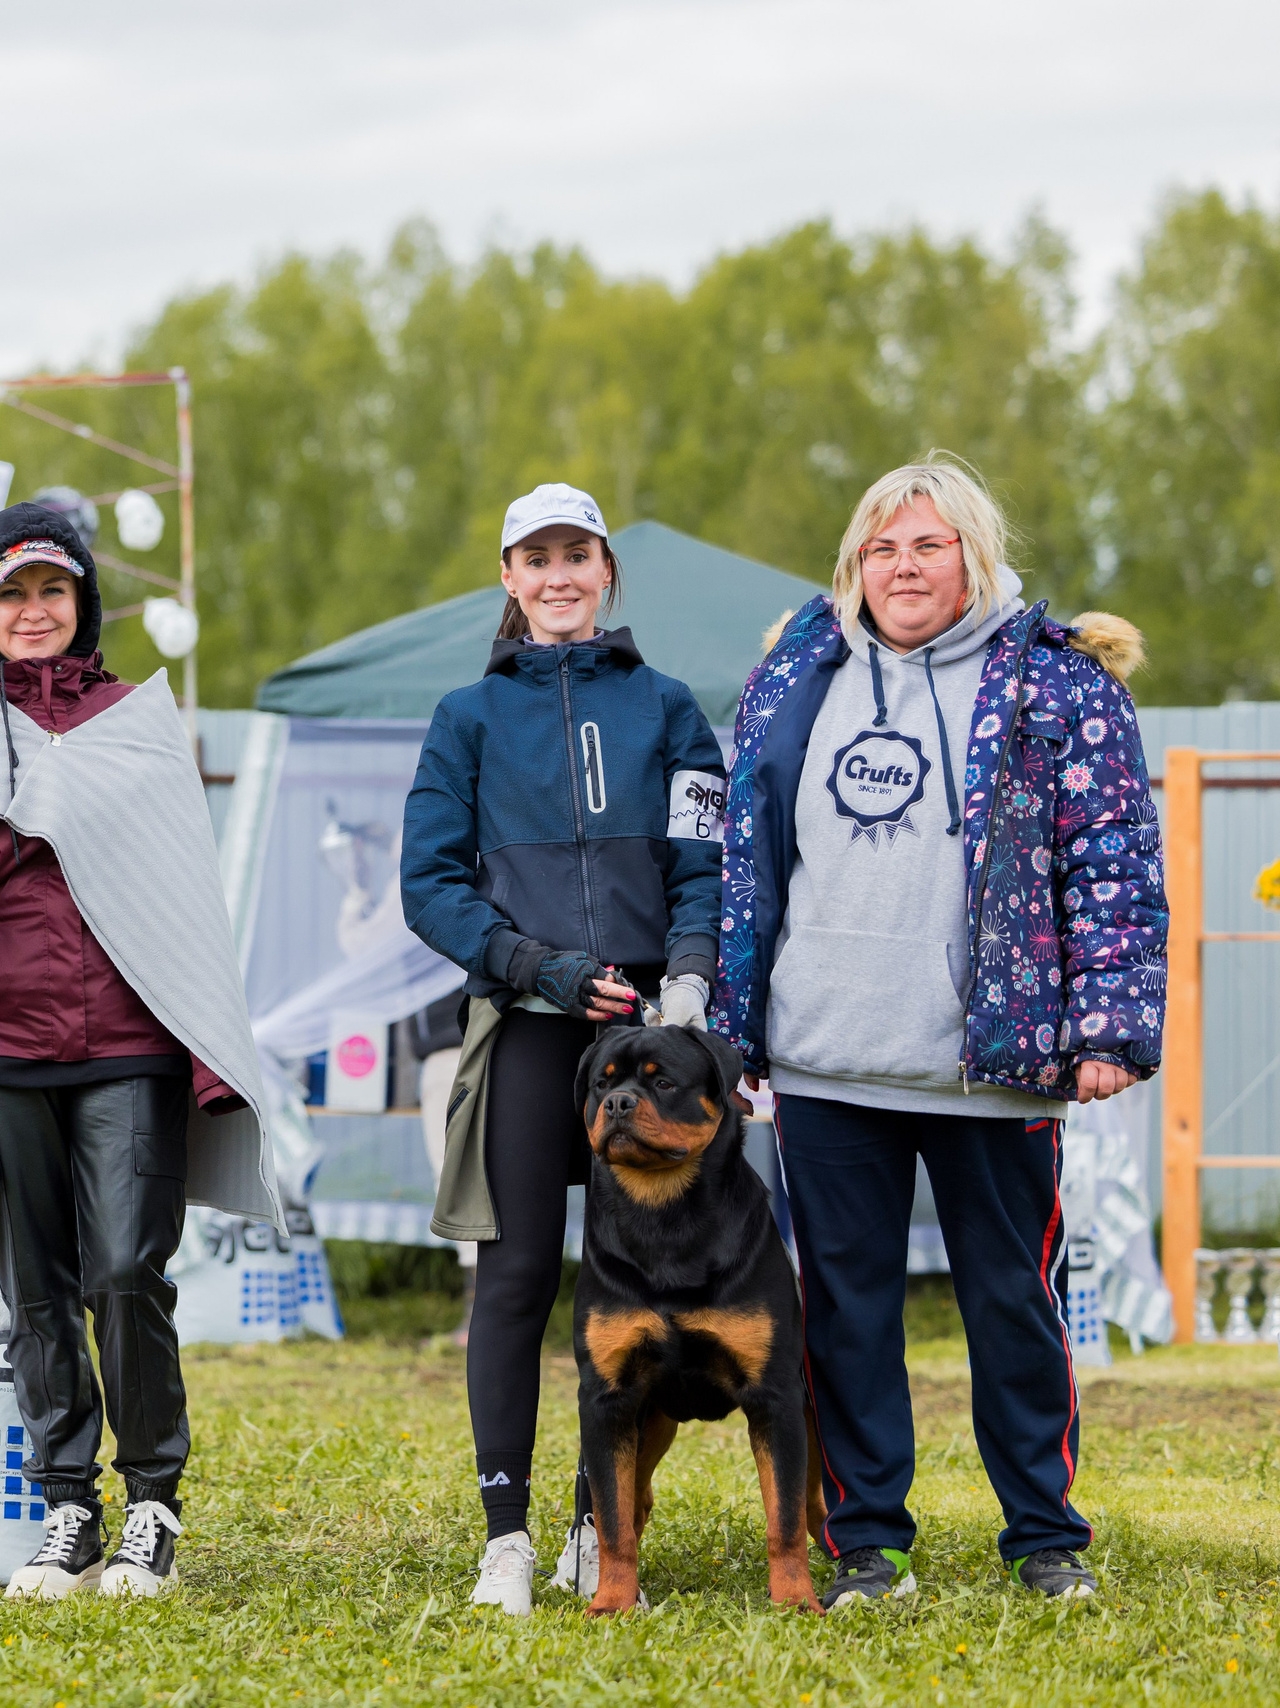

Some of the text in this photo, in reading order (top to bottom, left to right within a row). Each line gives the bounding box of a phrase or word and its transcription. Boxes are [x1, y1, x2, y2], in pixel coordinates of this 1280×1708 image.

[845, 755, 913, 786] Crufts
[858, 785, 877, 793] SINCE
[696, 814, 710, 838] 6
